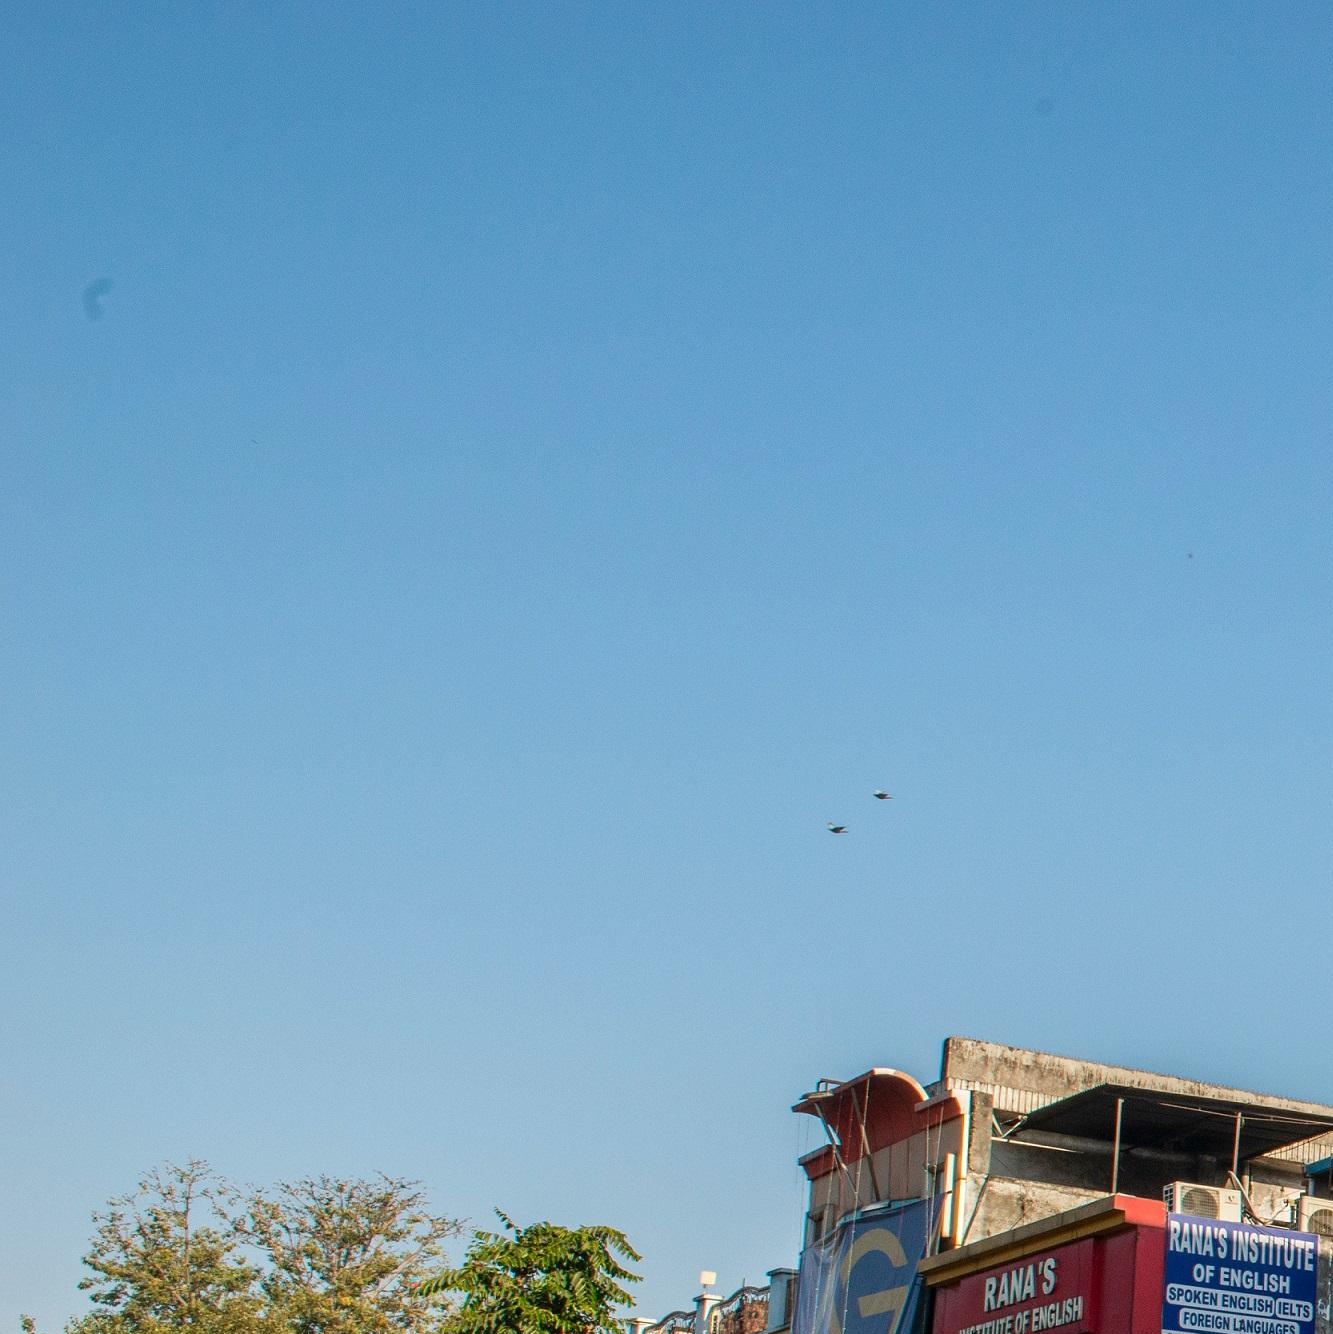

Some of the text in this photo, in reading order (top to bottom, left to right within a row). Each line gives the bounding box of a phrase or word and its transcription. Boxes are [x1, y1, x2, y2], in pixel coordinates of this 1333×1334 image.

[1169, 1219, 1315, 1272] RANA'S INSTITUTE
[983, 1257, 1058, 1313] RANA'S
[1193, 1263, 1291, 1295] OF ENGLISH
[1015, 1311, 1030, 1334] OF
[1031, 1296, 1084, 1332] ENGLISH
[1168, 1286, 1311, 1319] SPOKEN ENGLISH IELTS
[1183, 1311, 1230, 1331] FOREIGN
